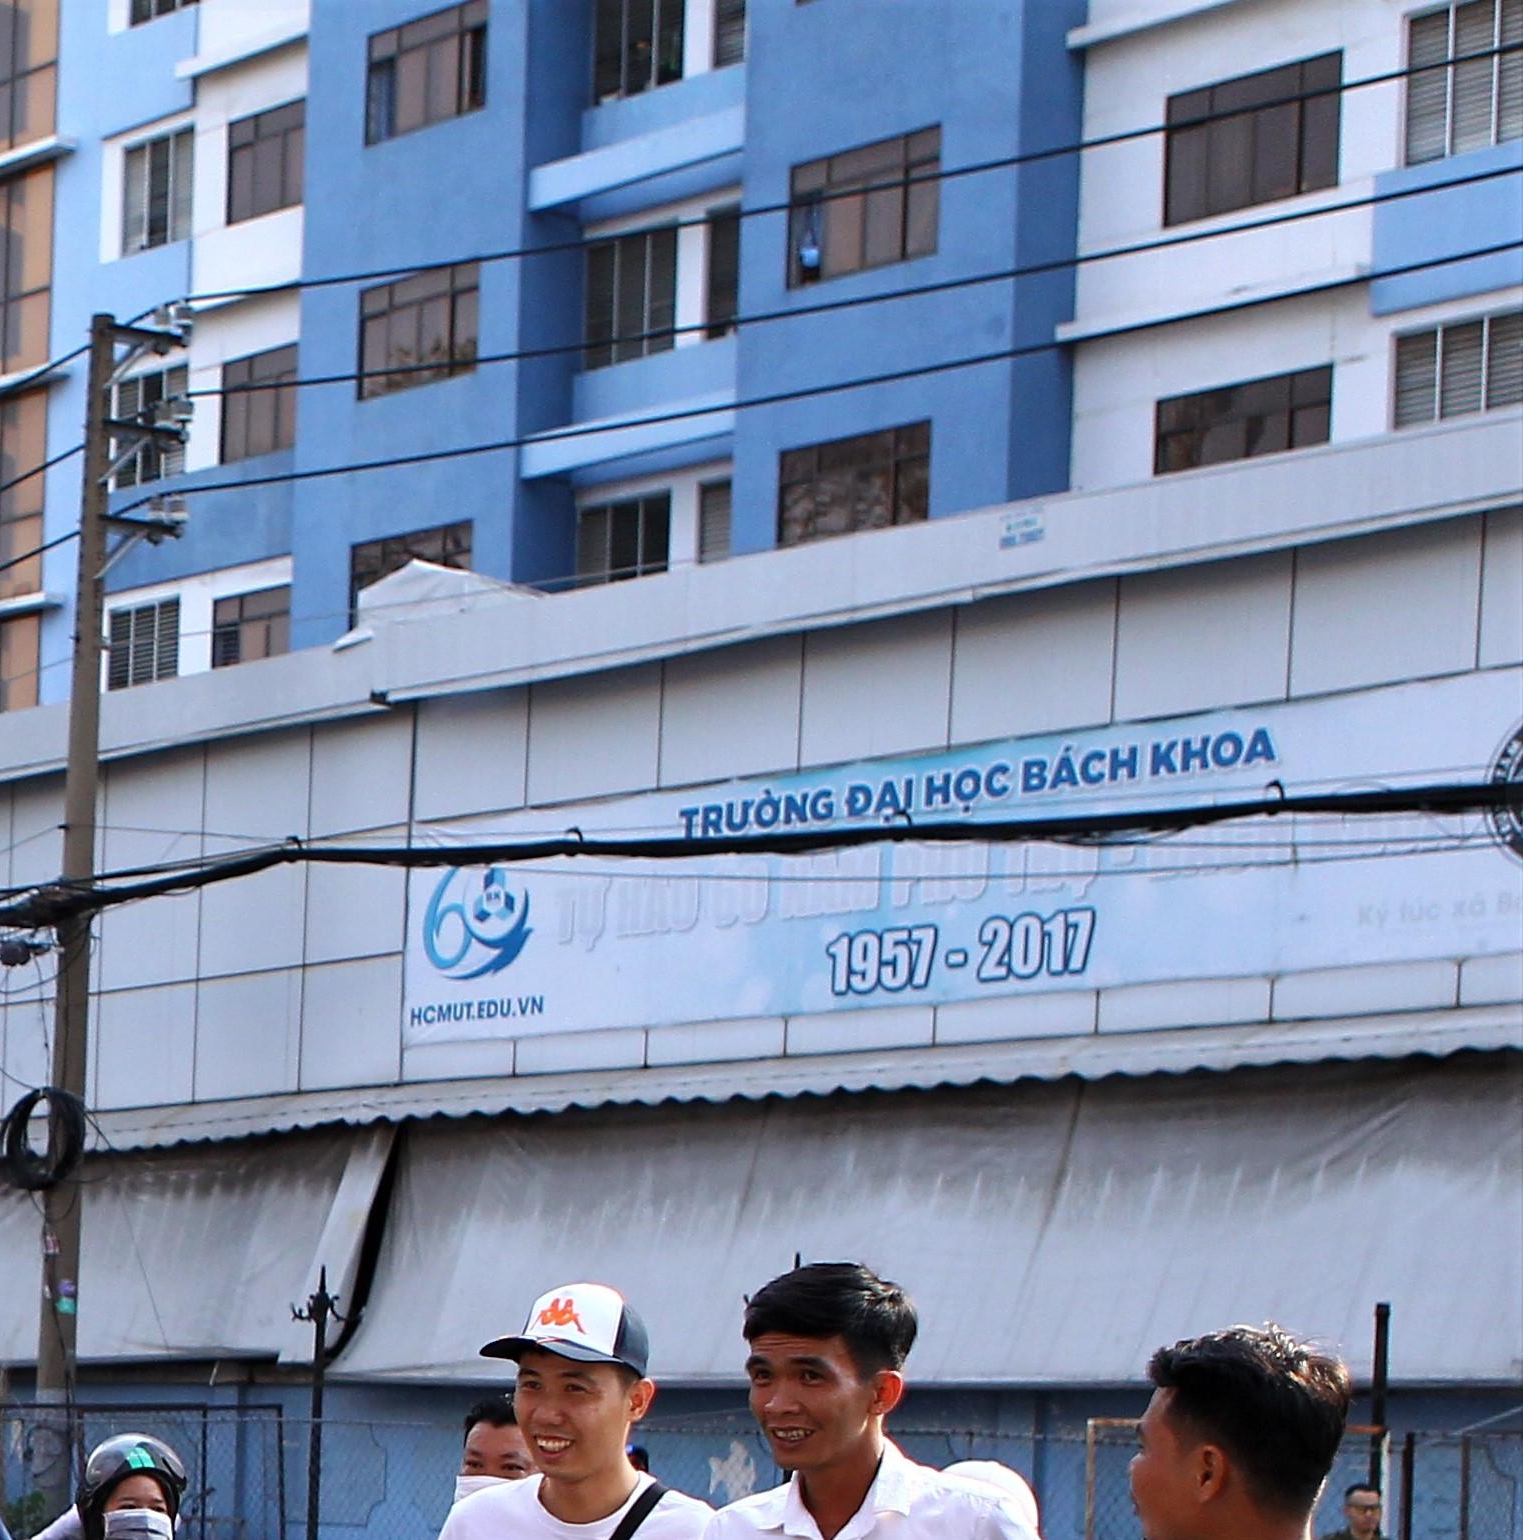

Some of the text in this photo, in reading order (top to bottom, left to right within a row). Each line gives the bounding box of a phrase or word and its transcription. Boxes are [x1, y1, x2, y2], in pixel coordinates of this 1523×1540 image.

[680, 727, 1276, 840] TRƯỜNG ĐẠI HỌC BÁCH KHOA
[825, 924, 940, 998] 1957
[977, 908, 1097, 984] 2017
[410, 995, 545, 1028] HCMUT.EDU.VN
